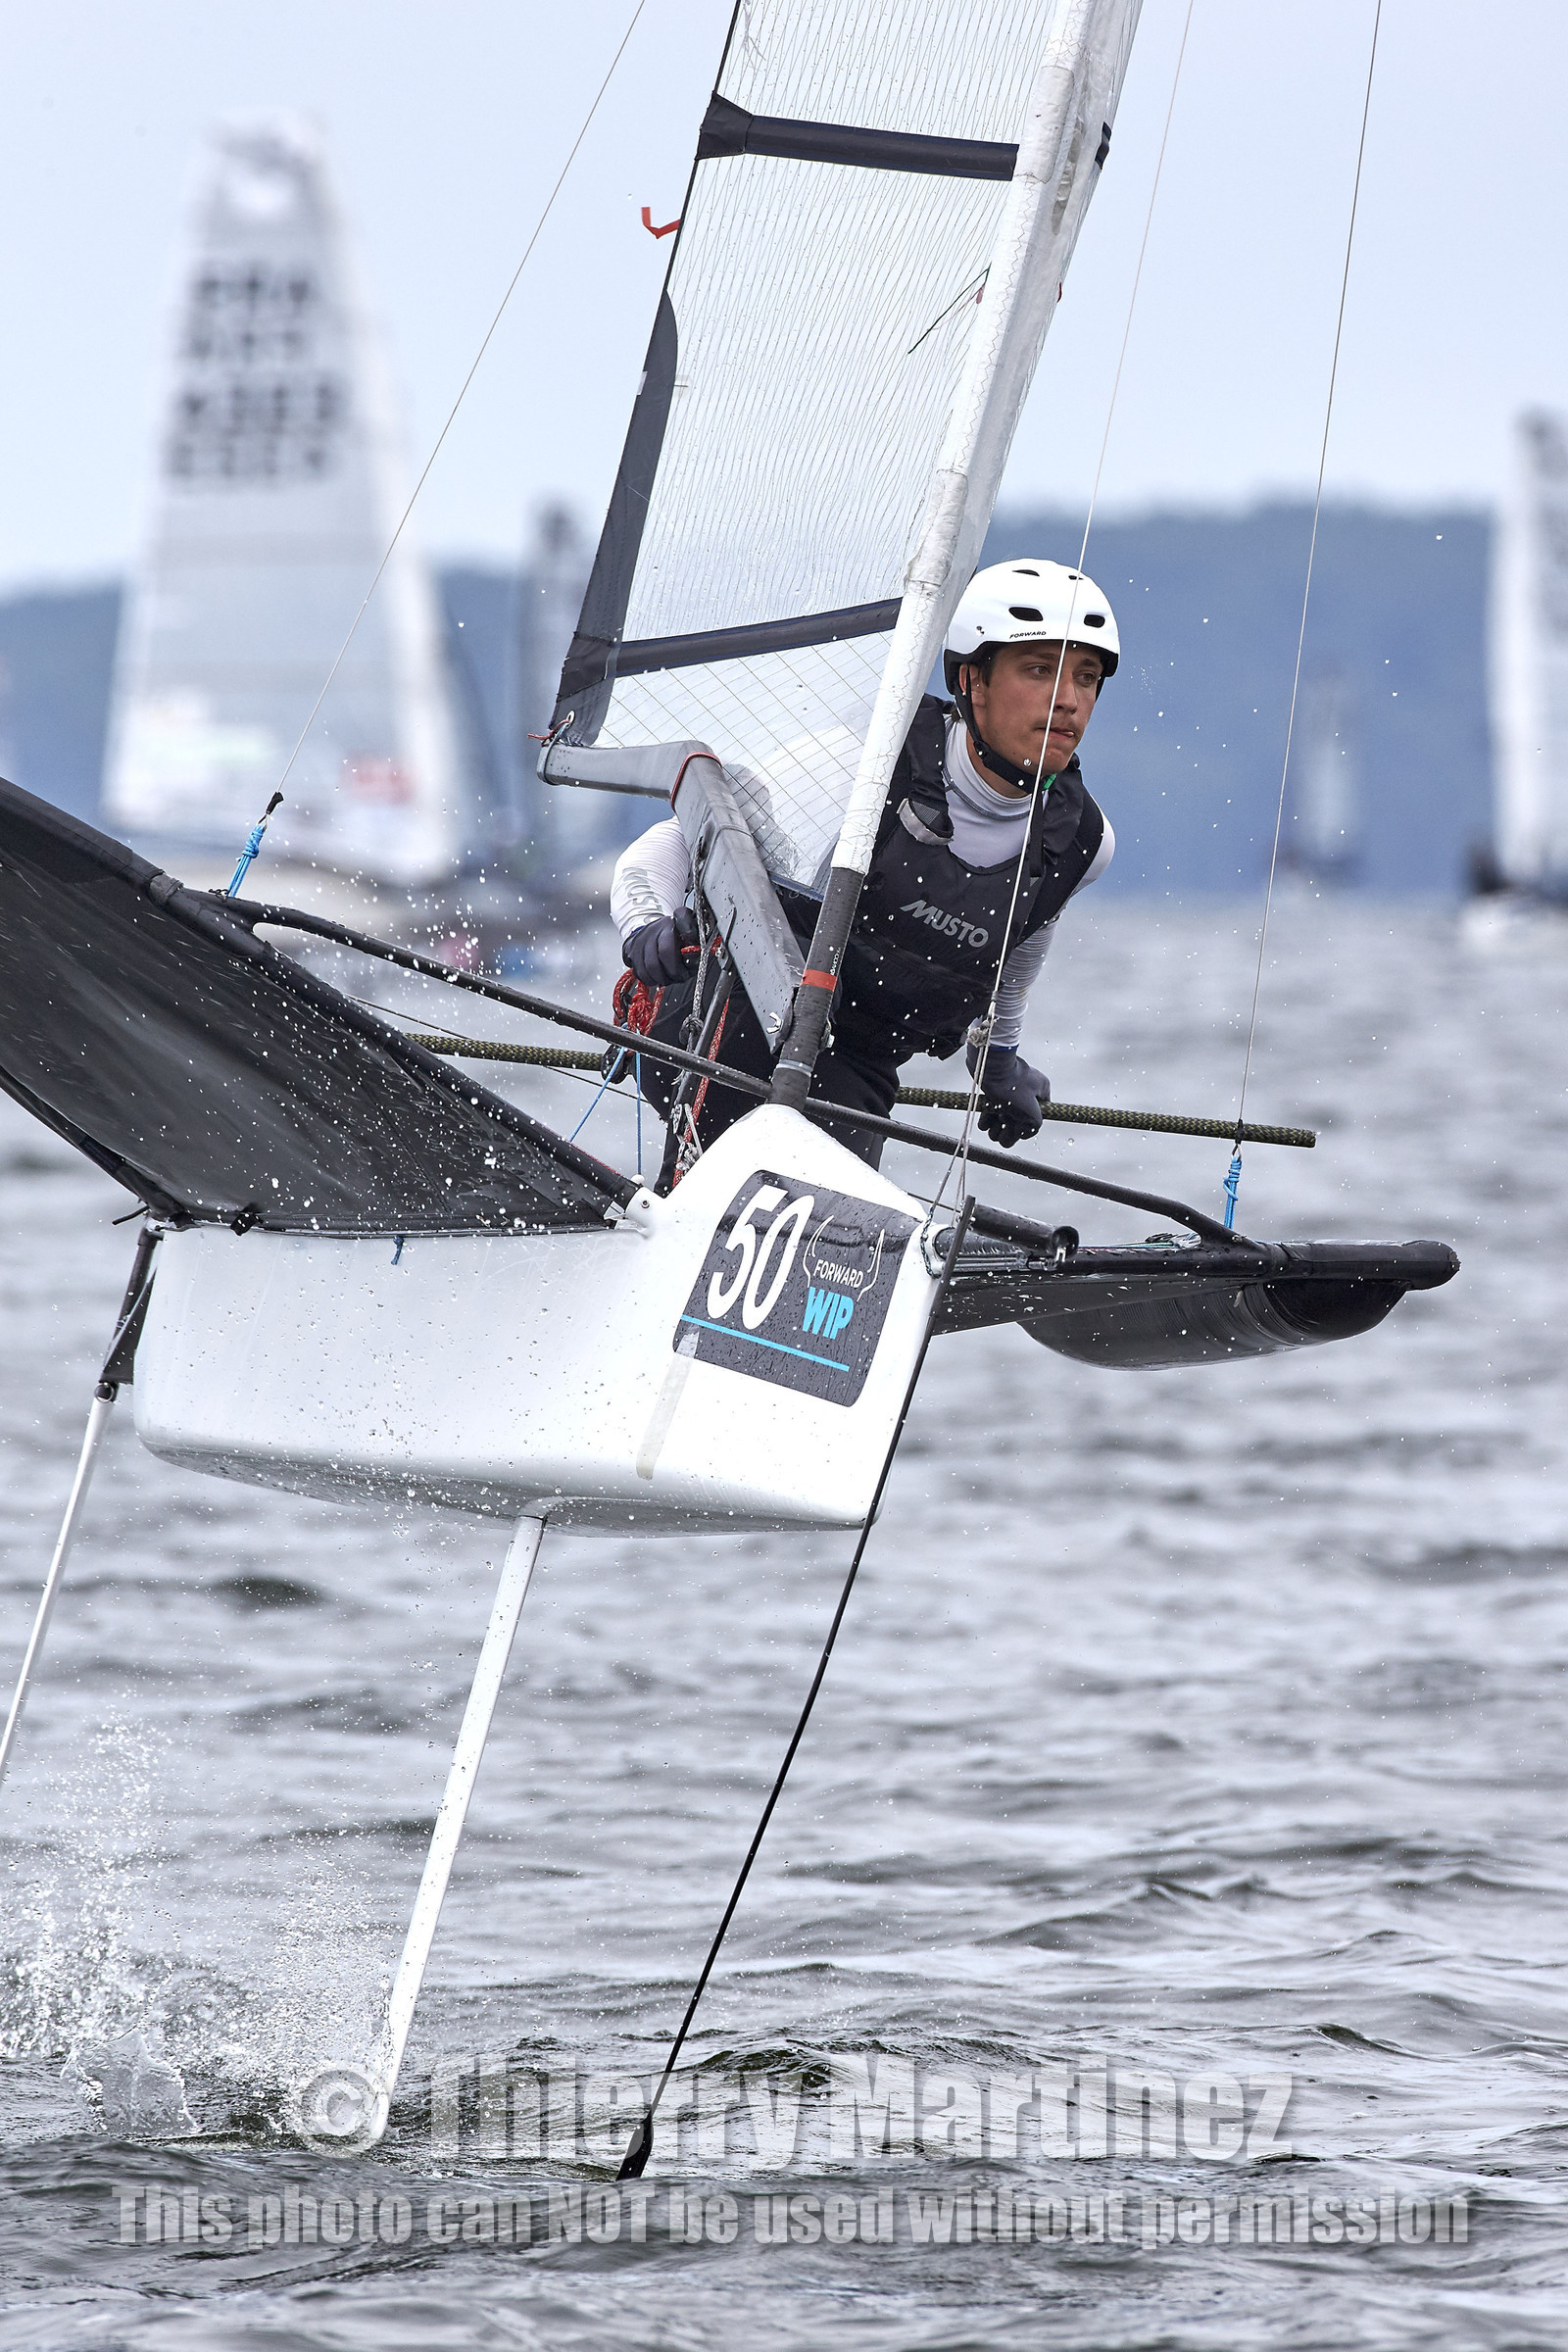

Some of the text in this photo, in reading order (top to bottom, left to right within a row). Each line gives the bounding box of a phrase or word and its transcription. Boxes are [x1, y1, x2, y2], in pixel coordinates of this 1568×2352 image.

[1008, 630, 1047, 639] FORWARD
[899, 899, 989, 948] MUSTO
[707, 1184, 815, 1330] 50
[812, 1258, 863, 1289] FORWARD
[802, 1286, 854, 1340] WIP
